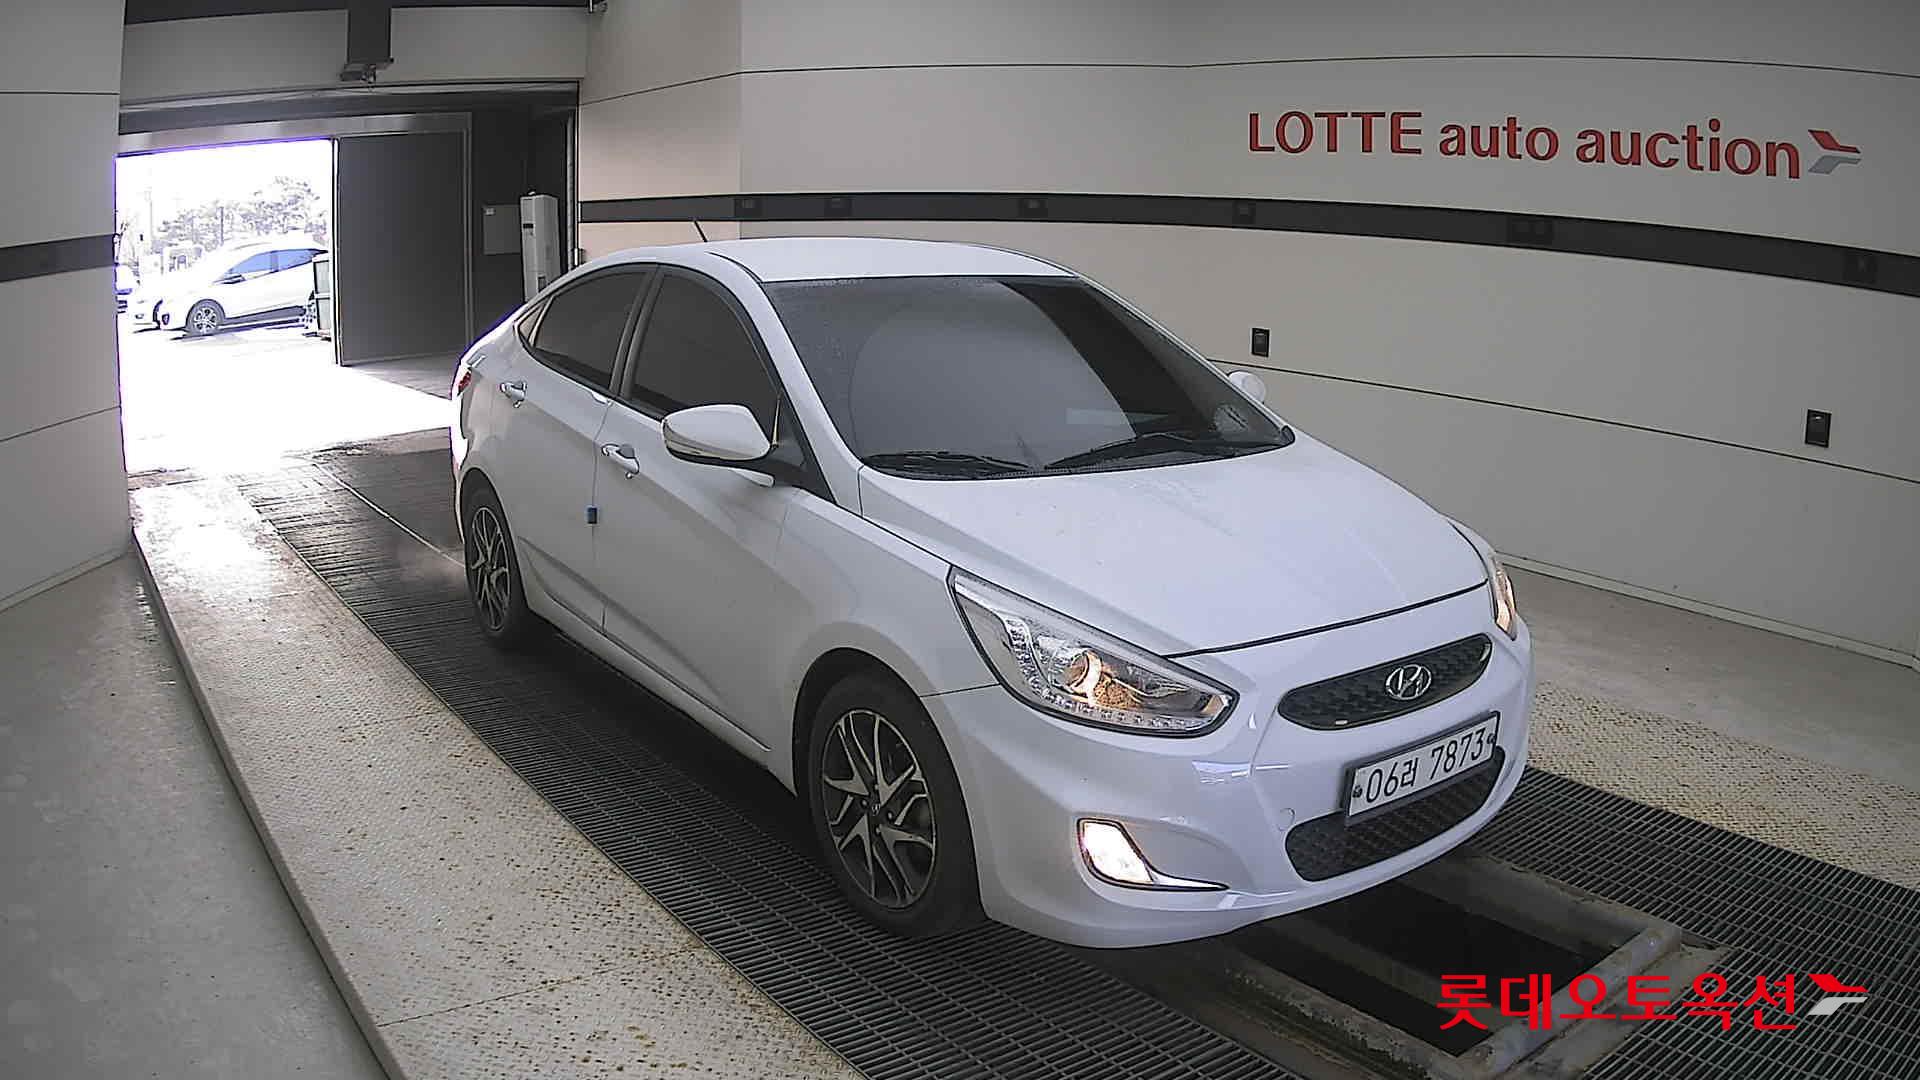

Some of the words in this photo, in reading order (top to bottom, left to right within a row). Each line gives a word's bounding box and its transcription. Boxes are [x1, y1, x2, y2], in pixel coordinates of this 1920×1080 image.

[1249, 110, 1422, 155] LOTTE
[1439, 116, 1560, 161] auto
[1576, 118, 1801, 180] auction
[1366, 757, 1419, 803] 06러
[1430, 726, 1487, 781] 7873
